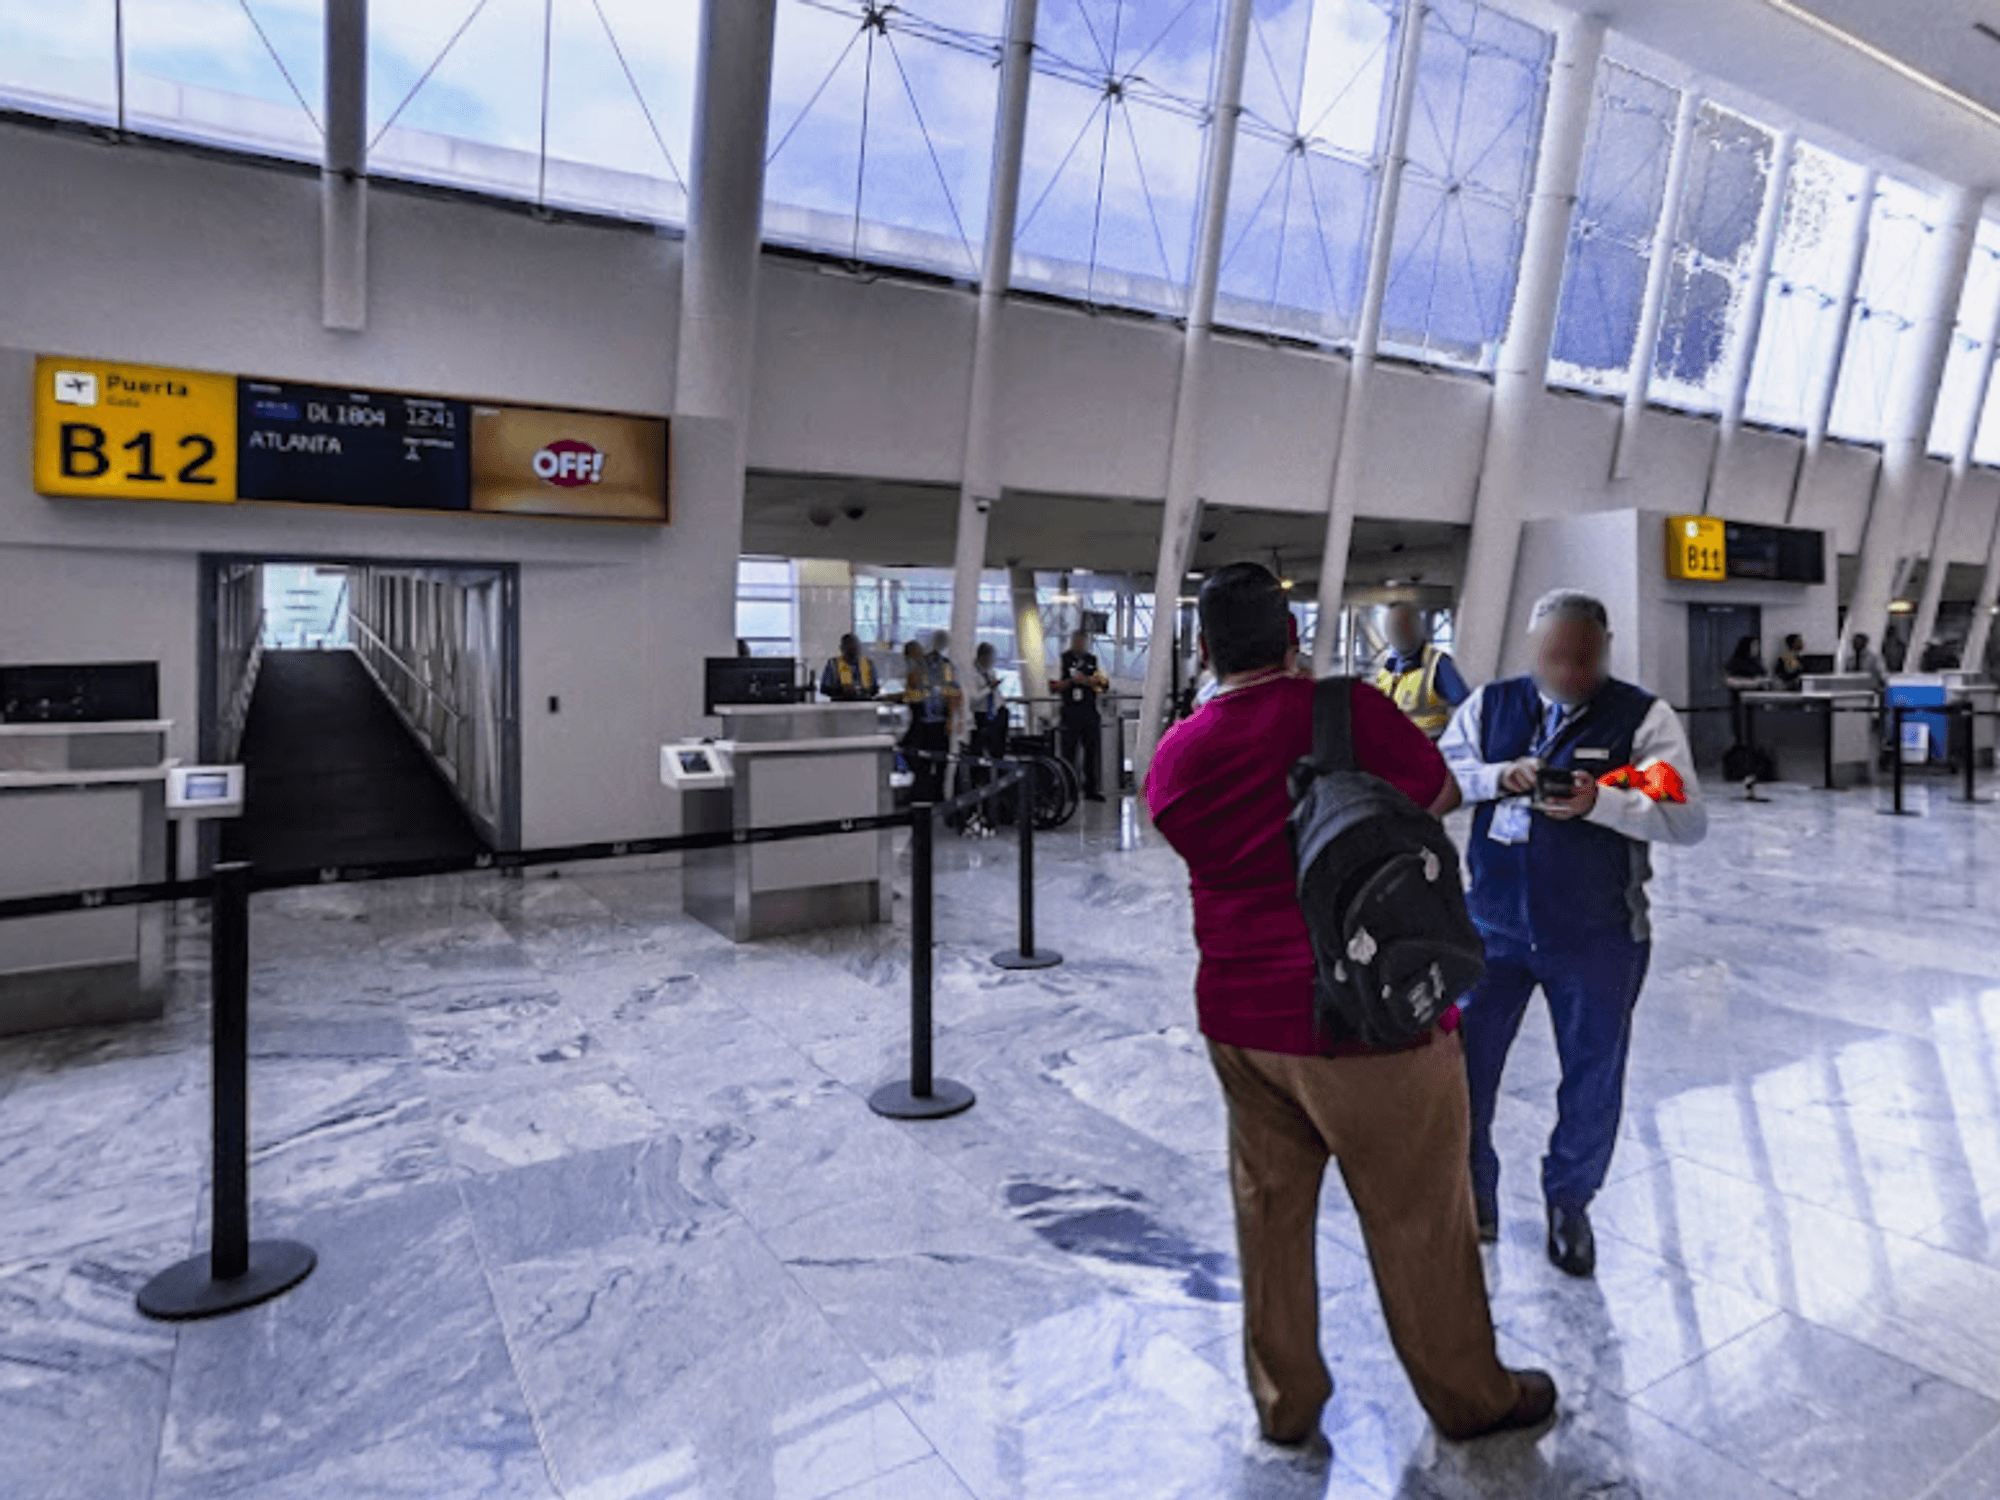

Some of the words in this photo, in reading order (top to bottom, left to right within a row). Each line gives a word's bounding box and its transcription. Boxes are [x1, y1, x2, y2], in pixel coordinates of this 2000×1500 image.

[106, 374, 188, 397] Puerta
[60, 422, 217, 485] B12
[249, 429, 344, 455] ATLANTA
[532, 449, 605, 483] OFF!
[1687, 544, 1721, 572] B11
